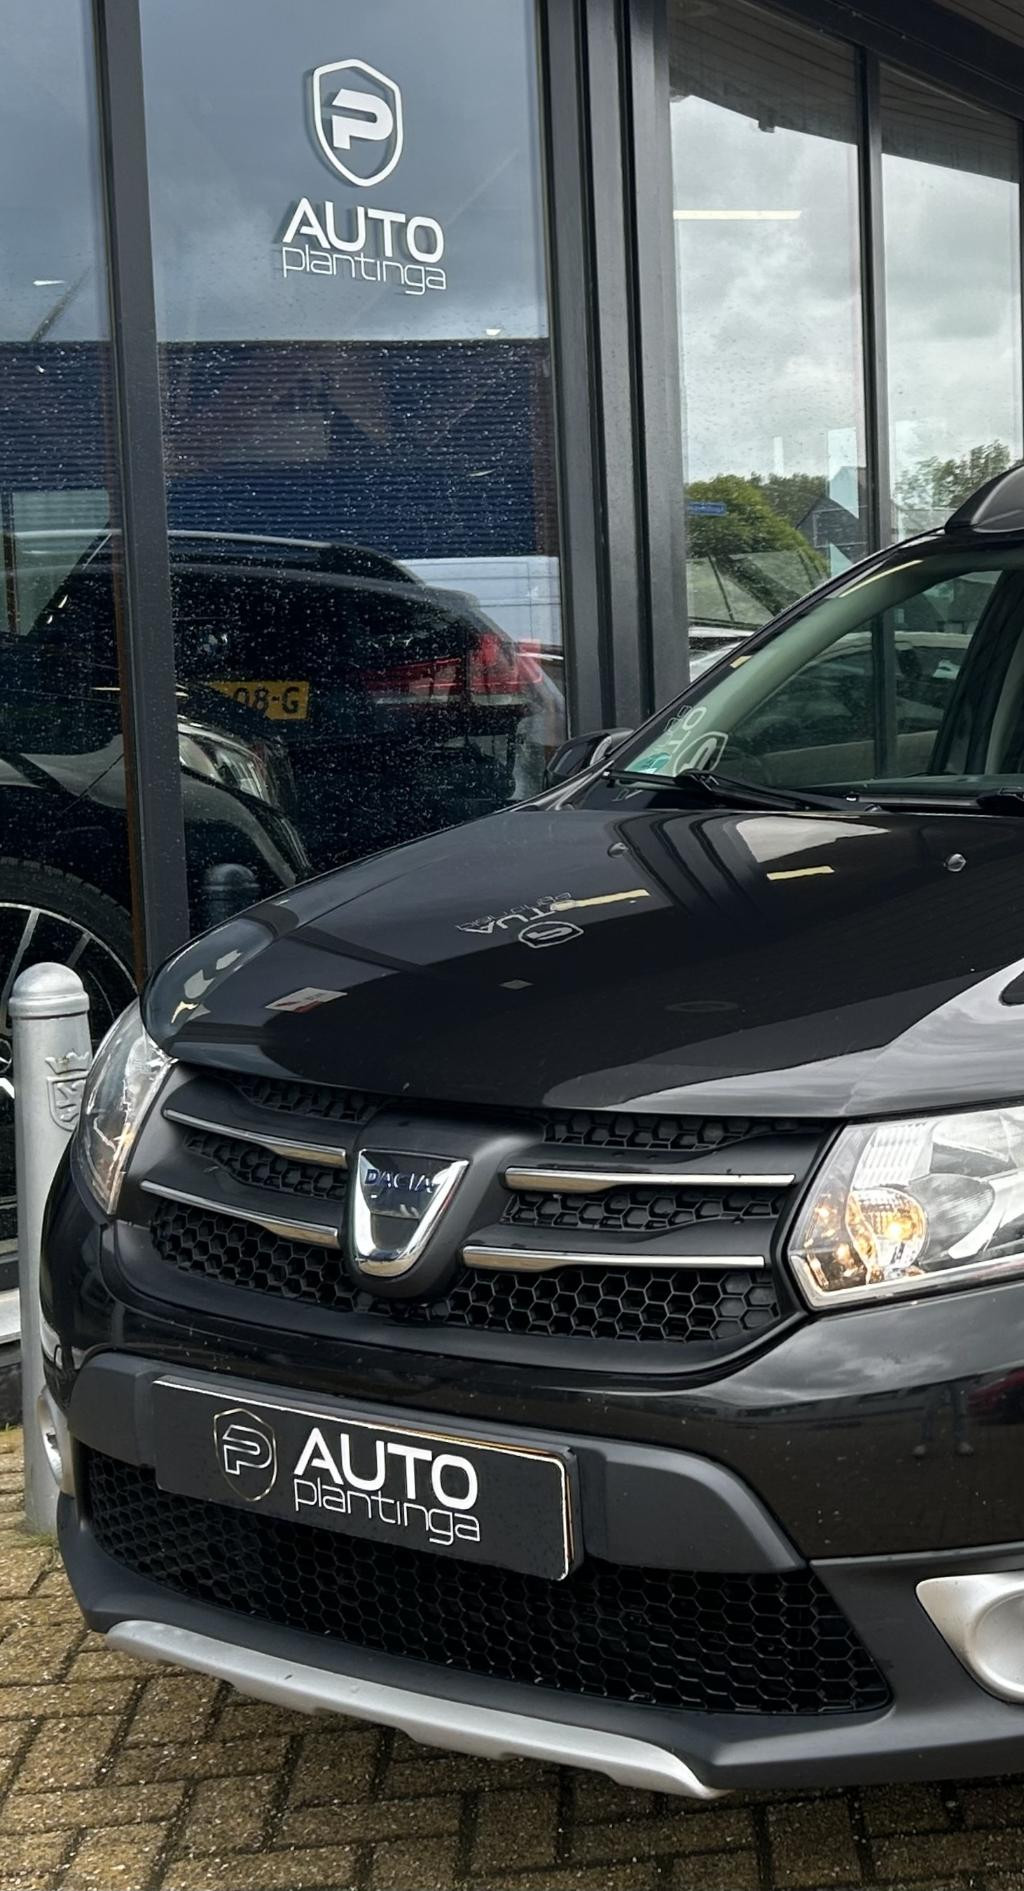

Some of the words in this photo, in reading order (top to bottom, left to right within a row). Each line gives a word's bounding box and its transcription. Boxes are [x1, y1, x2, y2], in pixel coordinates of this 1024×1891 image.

[282, 197, 445, 264] AUTO
[281, 244, 447, 296] plantinga
[365, 1168, 434, 1194] DACIA
[293, 1427, 478, 1511] AUTO
[293, 1477, 481, 1546] plantinga
